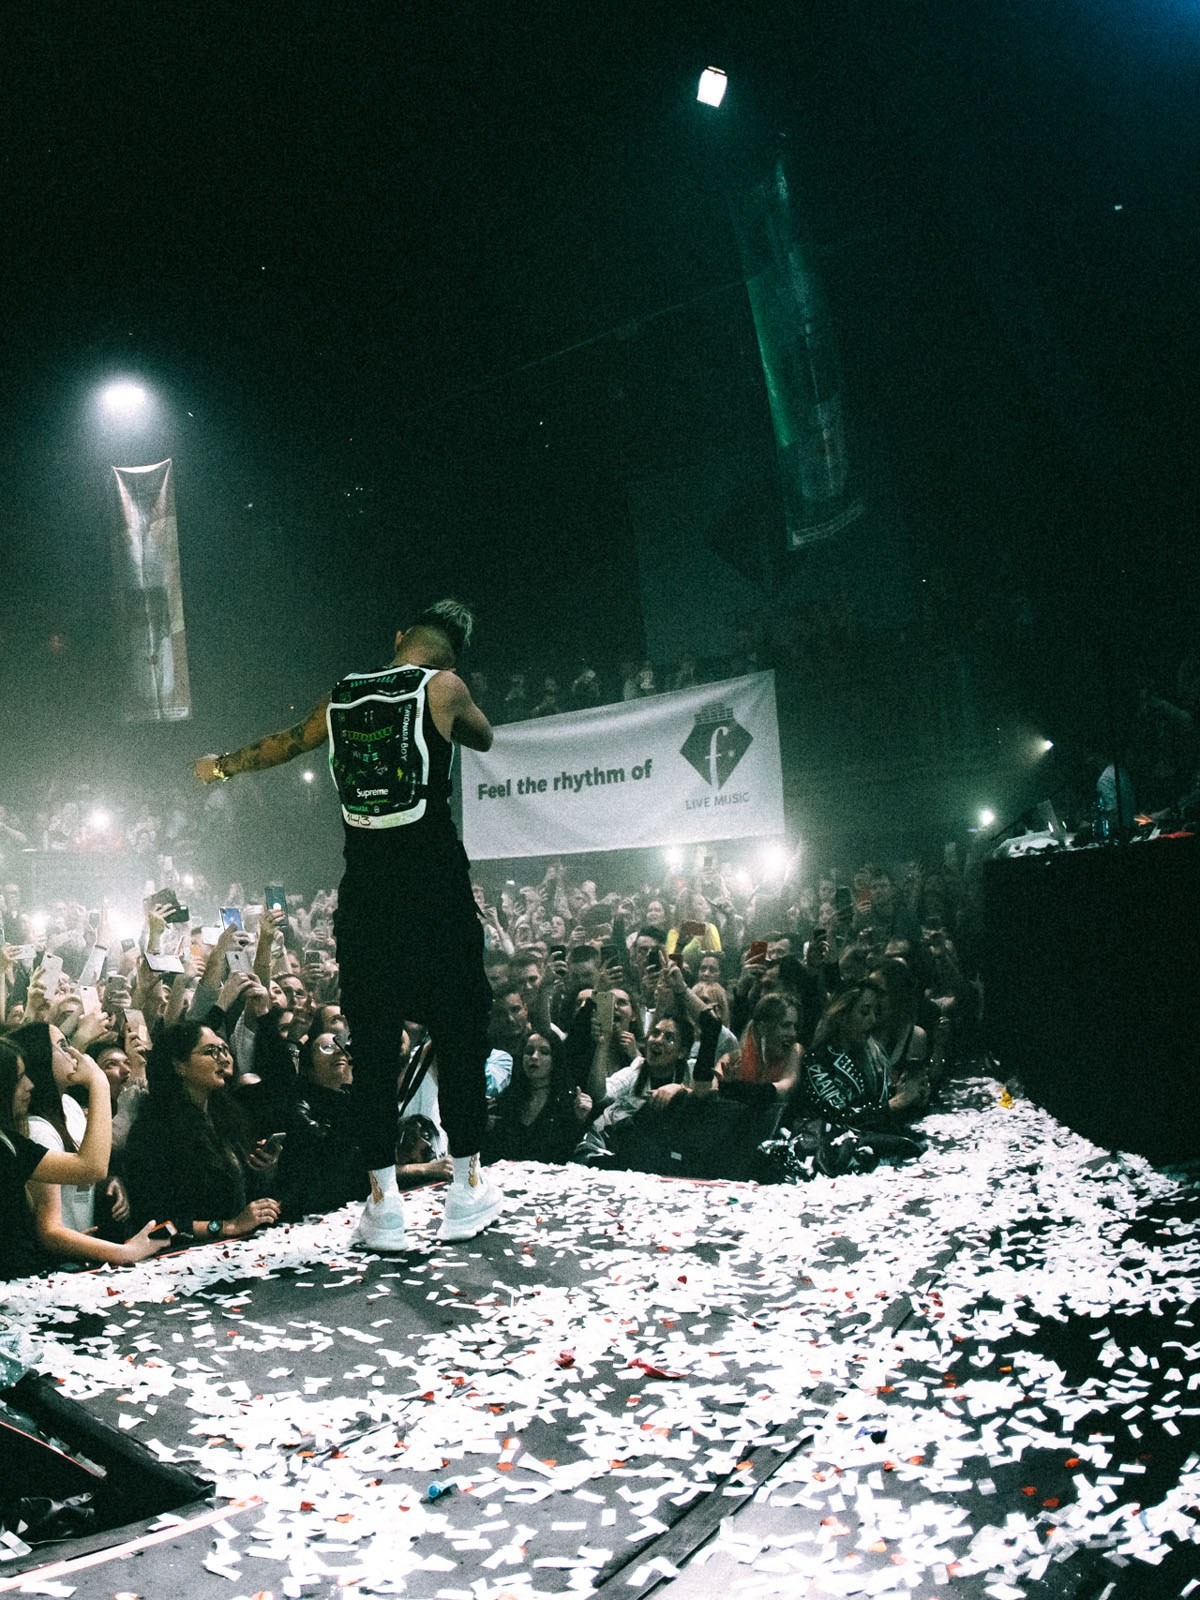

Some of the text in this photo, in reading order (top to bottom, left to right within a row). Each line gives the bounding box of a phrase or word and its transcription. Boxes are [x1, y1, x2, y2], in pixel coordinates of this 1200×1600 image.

[400, 703, 412, 762] SAYONARA BOY
[356, 788, 389, 799] Supreme
[478, 759, 653, 800] Feel the rhythm of
[685, 792, 750, 810] LIVE MUSIC
